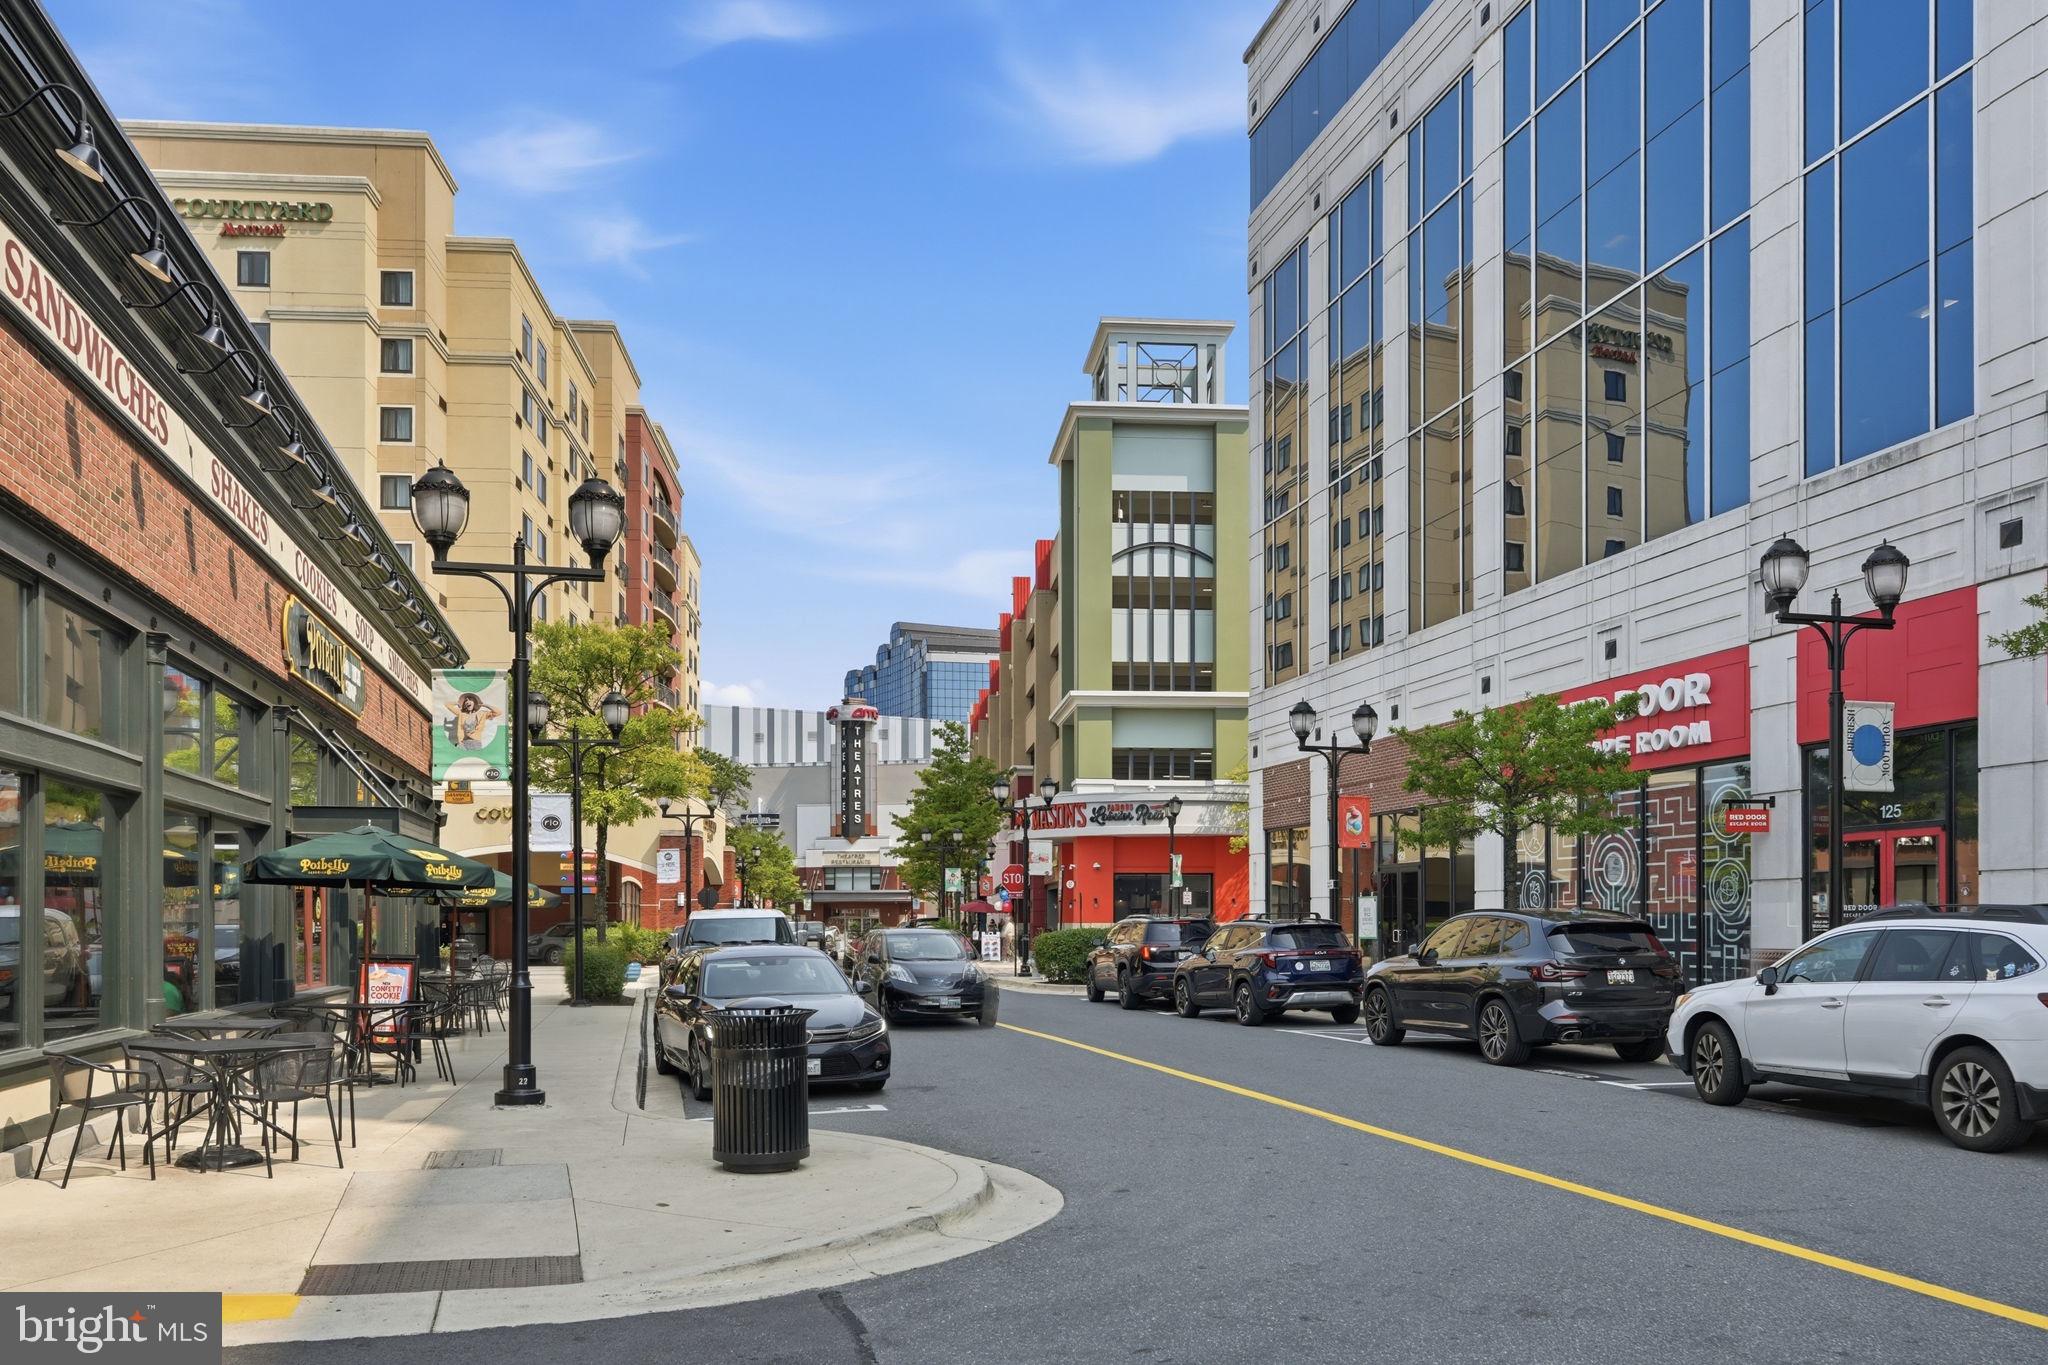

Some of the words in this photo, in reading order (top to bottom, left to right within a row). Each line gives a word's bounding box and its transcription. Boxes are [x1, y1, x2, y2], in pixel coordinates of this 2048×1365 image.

[172, 198, 333, 221] COURTYARD
[5, 239, 169, 446] SANDWICHES
[211, 458, 268, 546] SHAKES
[295, 550, 337, 616] COOKIES
[355, 614, 375, 652] SOUP
[388, 648, 419, 697] SMOOTHIES
[1636, 720, 1712, 754] ROOM
[1030, 802, 1087, 831] MASON'S
[1880, 804, 1902, 818] 125
[300, 856, 350, 875] Potbelly
[425, 862, 463, 880] Potbelly
[371, 992, 401, 1000] COOKIE
